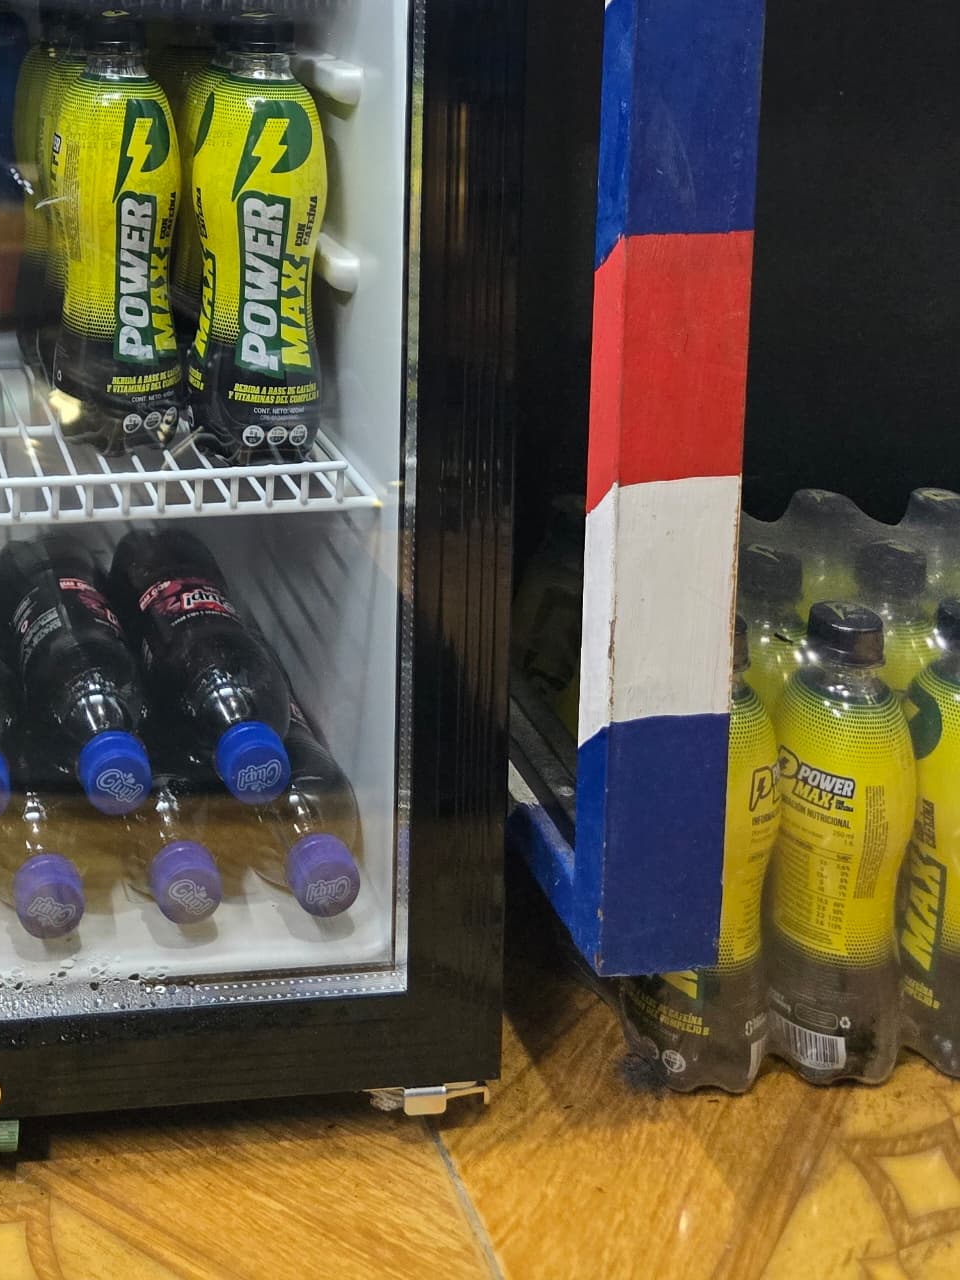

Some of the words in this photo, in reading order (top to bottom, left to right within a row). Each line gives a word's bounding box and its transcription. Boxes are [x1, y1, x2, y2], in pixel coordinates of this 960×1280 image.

[295, 223, 306, 246] CON
[119, 197, 153, 359] POWER
[242, 197, 284, 371] POWER
[150, 253, 176, 350] MAX
[281, 259, 311, 368] MAX
[234, 392, 275, 404] VITAMINAS
[261, 386, 267, 394] A
[794, 781, 833, 809] MAX
[798, 765, 855, 796] POWER
[806, 808, 851, 829] NUTRICIONAL
[902, 863, 940, 971] MAX
